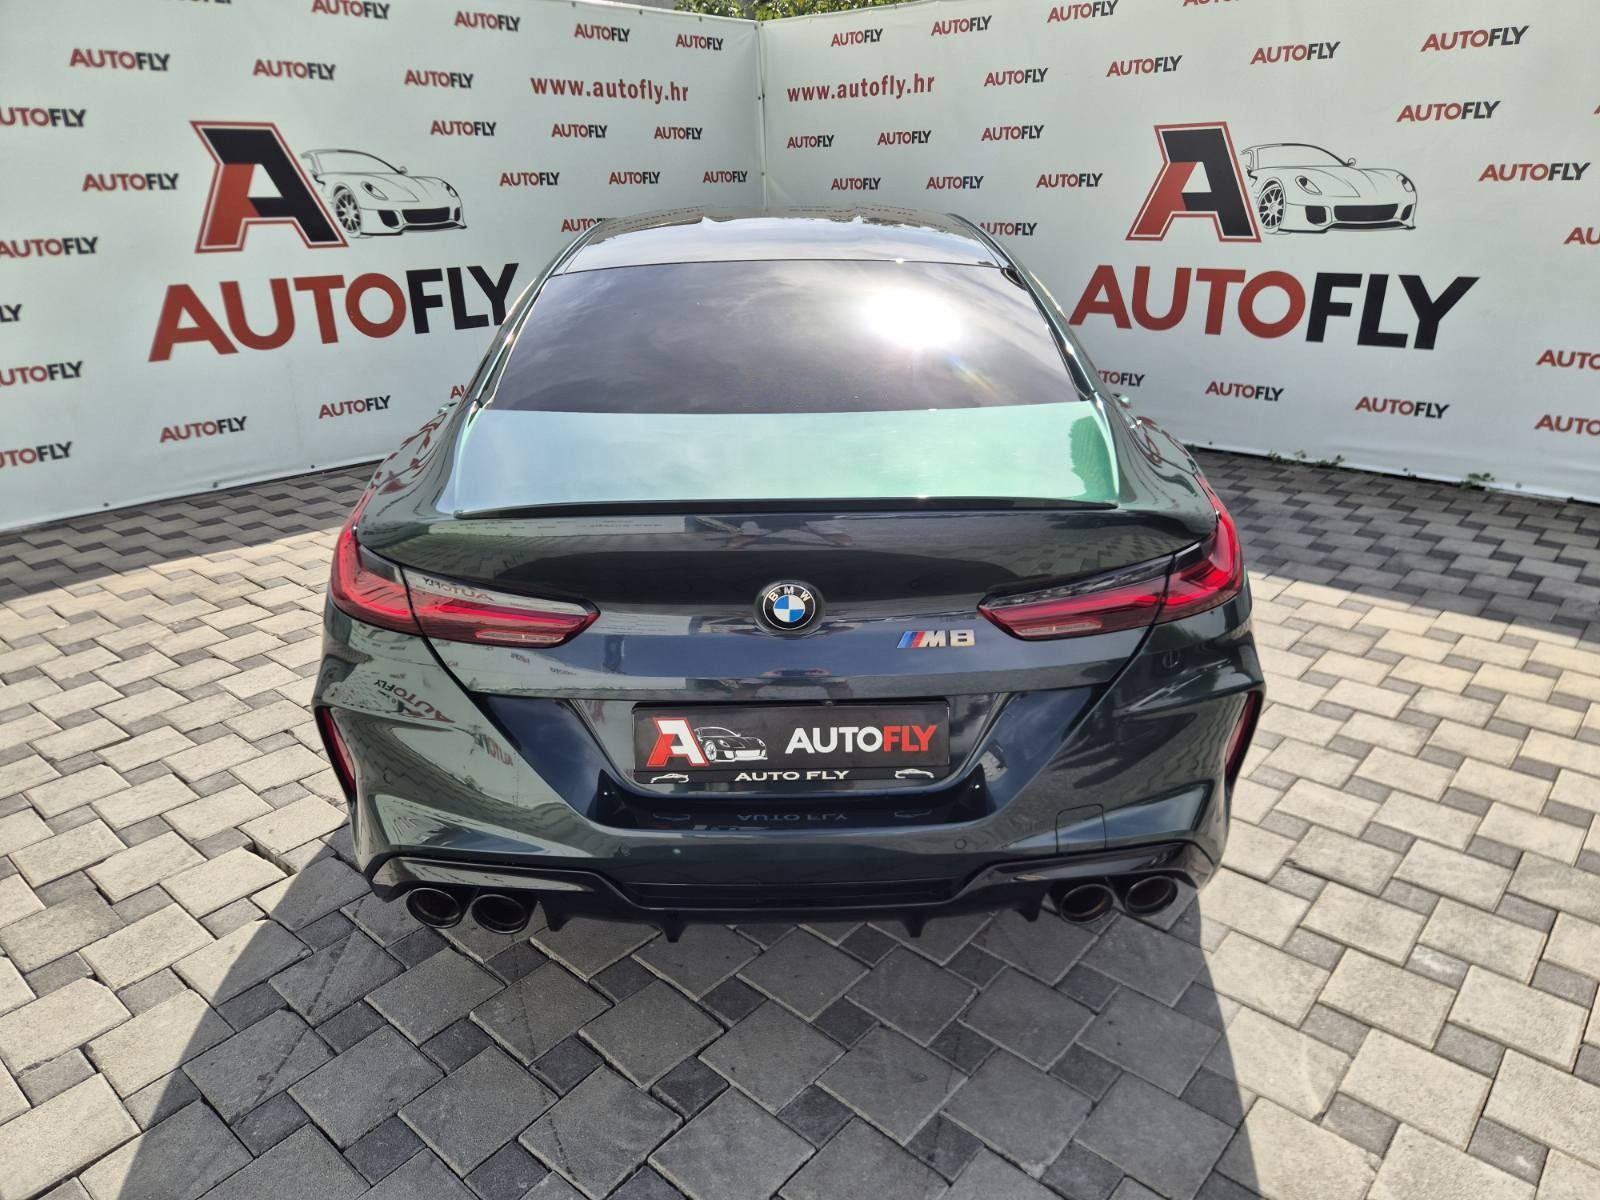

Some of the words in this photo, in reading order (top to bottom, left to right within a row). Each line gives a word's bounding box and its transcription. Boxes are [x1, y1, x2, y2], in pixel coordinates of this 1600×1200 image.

[312, 0, 390, 19] AUTOFLY
[1047, 0, 1118, 23] AUTOFLY
[455, 11, 520, 32] AUTOFLY
[931, 15, 992, 36] AUTOFLY
[575, 24, 630, 42] AUTOFLY
[831, 28, 883, 47] AUTOFLY
[1421, 25, 1529, 52] AUTOFLY
[676, 34, 723, 51] AUTOFLY
[70, 49, 170, 71] AUTOFLY
[1250, 41, 1340, 64] AUTOFLY
[253, 59, 336, 80] AUTOFLY
[1107, 55, 1182, 77] AUTOFLY
[405, 70, 473, 88] AUTOFLY
[984, 68, 1048, 86] AUTOFLY
[531, 78, 688, 104] www.autofly.hr
[787, 73, 934, 102] www.autofly.hr
[1397, 101, 1501, 122] AUTOFLY
[431, 121, 496, 136] AUTOFLY
[552, 124, 607, 138] AUTOFLY
[654, 127, 703, 140] AUTOFLY
[877, 130, 931, 145] AUTOFLY
[981, 125, 1044, 141] AUTOFLY
[787, 135, 834, 148] AUTOFLY
[500, 172, 559, 186] AUTOFLY
[609, 172, 660, 184] AUTOFLY
[703, 171, 747, 183] AUTOFLY
[1036, 173, 1103, 188] AUTOFLY
[1479, 163, 1590, 181] AUTOFLY
[83, 173, 179, 191] AUTOFLY
[831, 178, 881, 190] AUTOFLY
[926, 176, 984, 189] AUTOFLY
[0, 237, 98, 258] AUTOFLY
[149, 263, 519, 362] AUTOFLY
[1068, 265, 1480, 350] AUTOFLY
[0, 361, 82, 386] UTOFLY
[1098, 371, 1145, 387] TOFLY
[1205, 381, 1284, 401] AUTOFLY
[319, 395, 390, 418] AUTOFLY
[1355, 397, 1450, 419] AUTOFLY
[160, 416, 247, 443] AUTOFLY
[768, 586, 811, 602] BMW
[918, 629, 975, 647] M8
[785, 725, 938, 754] AUTOFLY
[734, 771, 800, 782] AUTO
[806, 770, 850, 781] FLY
